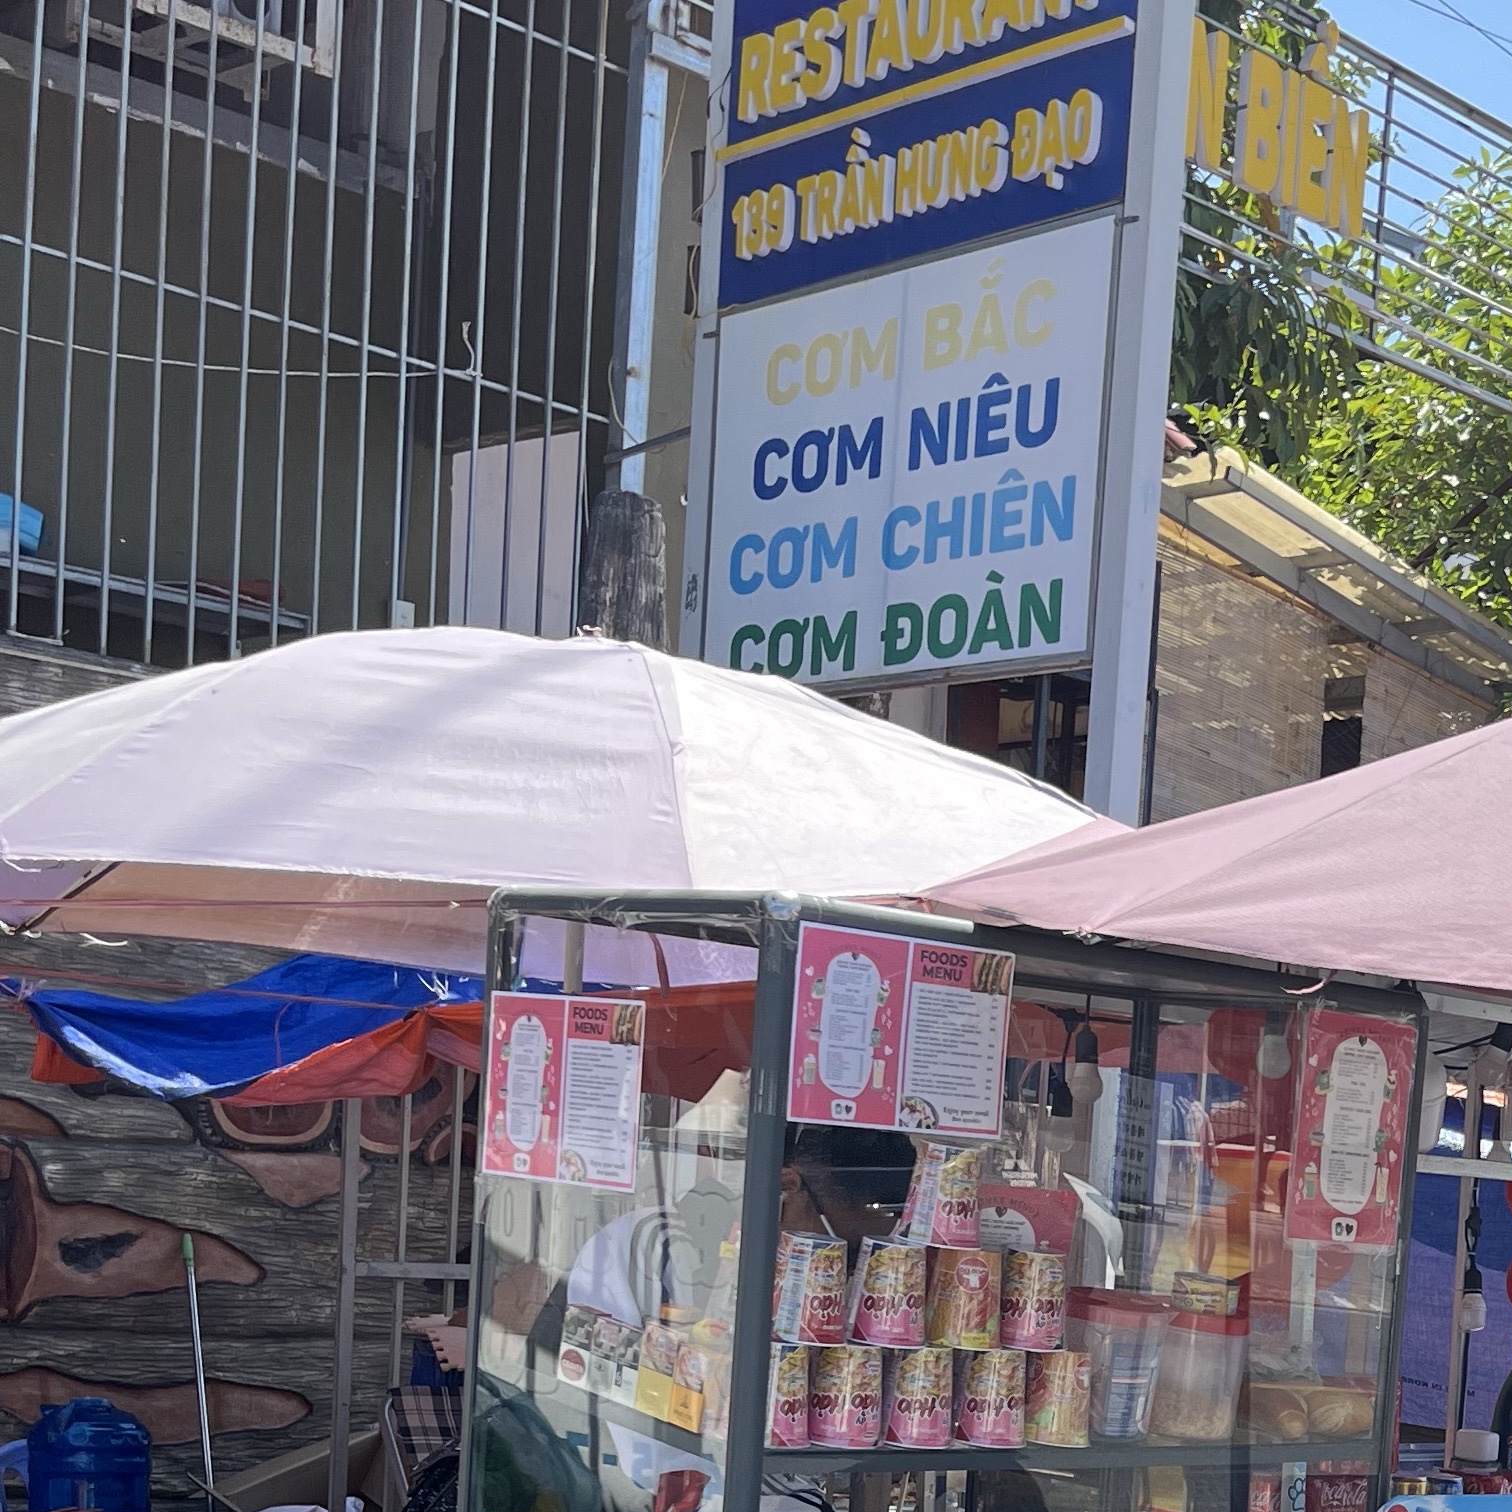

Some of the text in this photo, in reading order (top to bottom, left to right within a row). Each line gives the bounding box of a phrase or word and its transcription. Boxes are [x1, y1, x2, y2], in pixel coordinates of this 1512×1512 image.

[797, 127, 896, 244] TRẦN
[895, 118, 1009, 218] HƯNG
[1010, 88, 1103, 191] ĐẠO
[1232, 19, 1370, 240] BIỂN
[765, 256, 1059, 406] CƠM BẮC
[753, 371, 1062, 501] CƠM NIÊU
[729, 515, 859, 596] CƠM
[881, 467, 1078, 571] CHIÊN
[729, 569, 1064, 680] CƠM ĐOÀN
[572, 1006, 609, 1021] FOODS
[920, 949, 969, 968] FOODS
[922, 966, 964, 982] MENU
[574, 1021, 605, 1036] MENU
